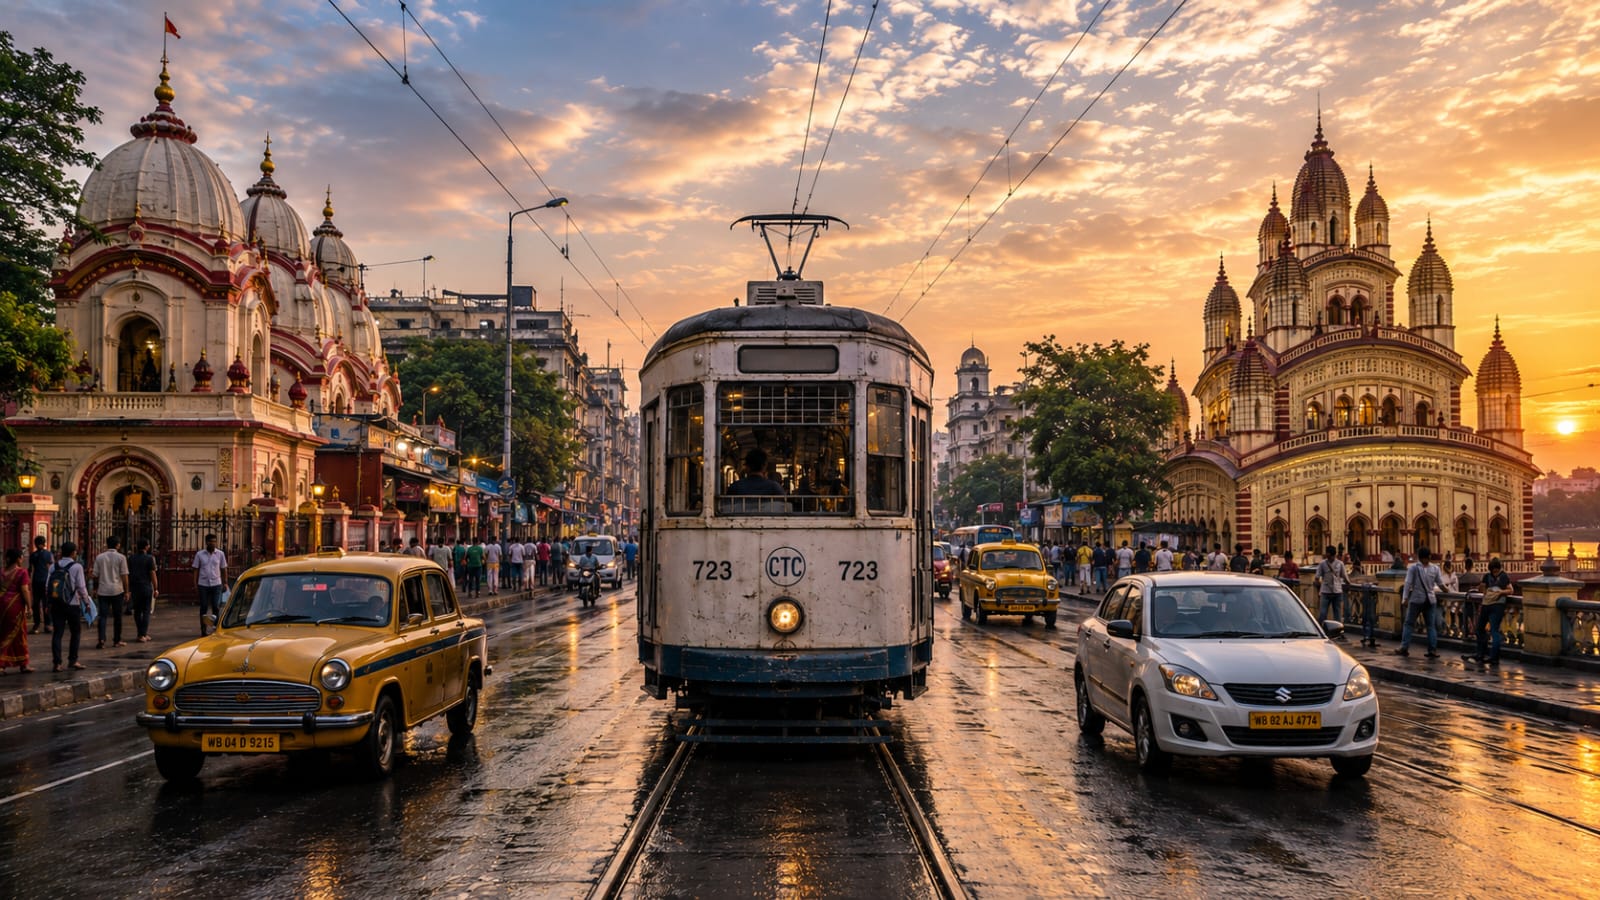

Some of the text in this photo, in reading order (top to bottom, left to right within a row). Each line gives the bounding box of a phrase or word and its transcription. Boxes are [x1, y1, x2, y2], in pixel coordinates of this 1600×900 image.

[693, 560, 732, 581] 723
[769, 556, 803, 577] CTC
[838, 560, 878, 581] 723
[1255, 715, 1267, 726] WB
[1283, 715, 1294, 726] AJ
[1296, 715, 1317, 726] 4774
[207, 736, 222, 748] WB
[225, 737, 236, 748] 04
[249, 737, 274, 748] 9215
